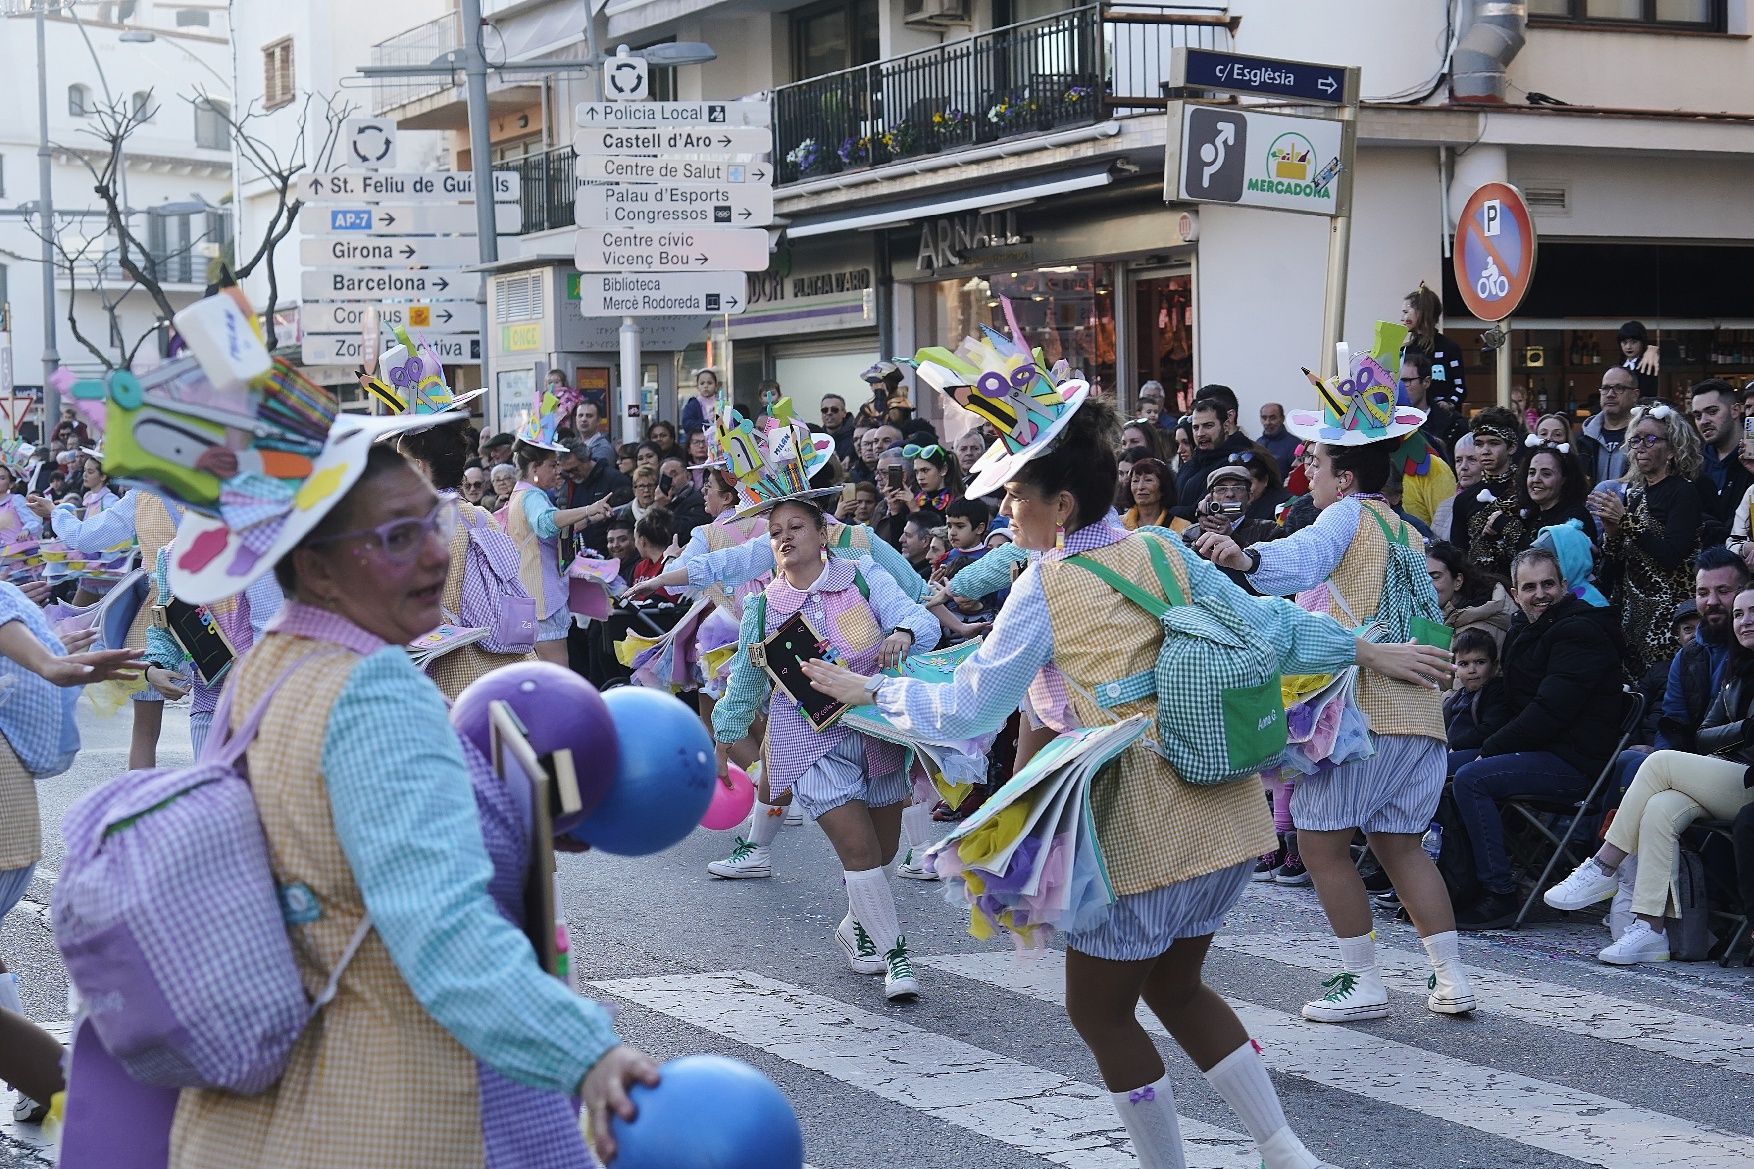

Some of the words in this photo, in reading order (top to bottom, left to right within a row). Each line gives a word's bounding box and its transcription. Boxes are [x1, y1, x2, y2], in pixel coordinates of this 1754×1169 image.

[1233, 64, 1295, 86] Església
[661, 104, 703, 120] Local
[602, 133, 661, 149] Castell
[667, 133, 712, 148] d'Aro
[604, 159, 655, 177] Centre
[659, 162, 678, 178] de
[683, 163, 721, 180] Salut
[330, 176, 354, 193] St.
[362, 176, 405, 193] Feliu
[413, 176, 434, 193] de
[443, 175, 509, 193] Guíls
[605, 187, 649, 202] Palau
[654, 187, 730, 205] d'Esports
[334, 212, 369, 228] AP-7
[614, 207, 708, 224] Congressos
[602, 232, 653, 247] Centre
[658, 231, 694, 247] cívic
[332, 241, 393, 259] Girona
[602, 251, 654, 269] Vicenç
[659, 251, 690, 266] Bou
[333, 274, 426, 291] Barcelona
[602, 277, 661, 291] Biblioteca
[602, 295, 639, 311] Mercè
[642, 294, 700, 310] Rodoreda
[512, 326, 537, 345] ONCE
[773, 433, 791, 456] MILAN
